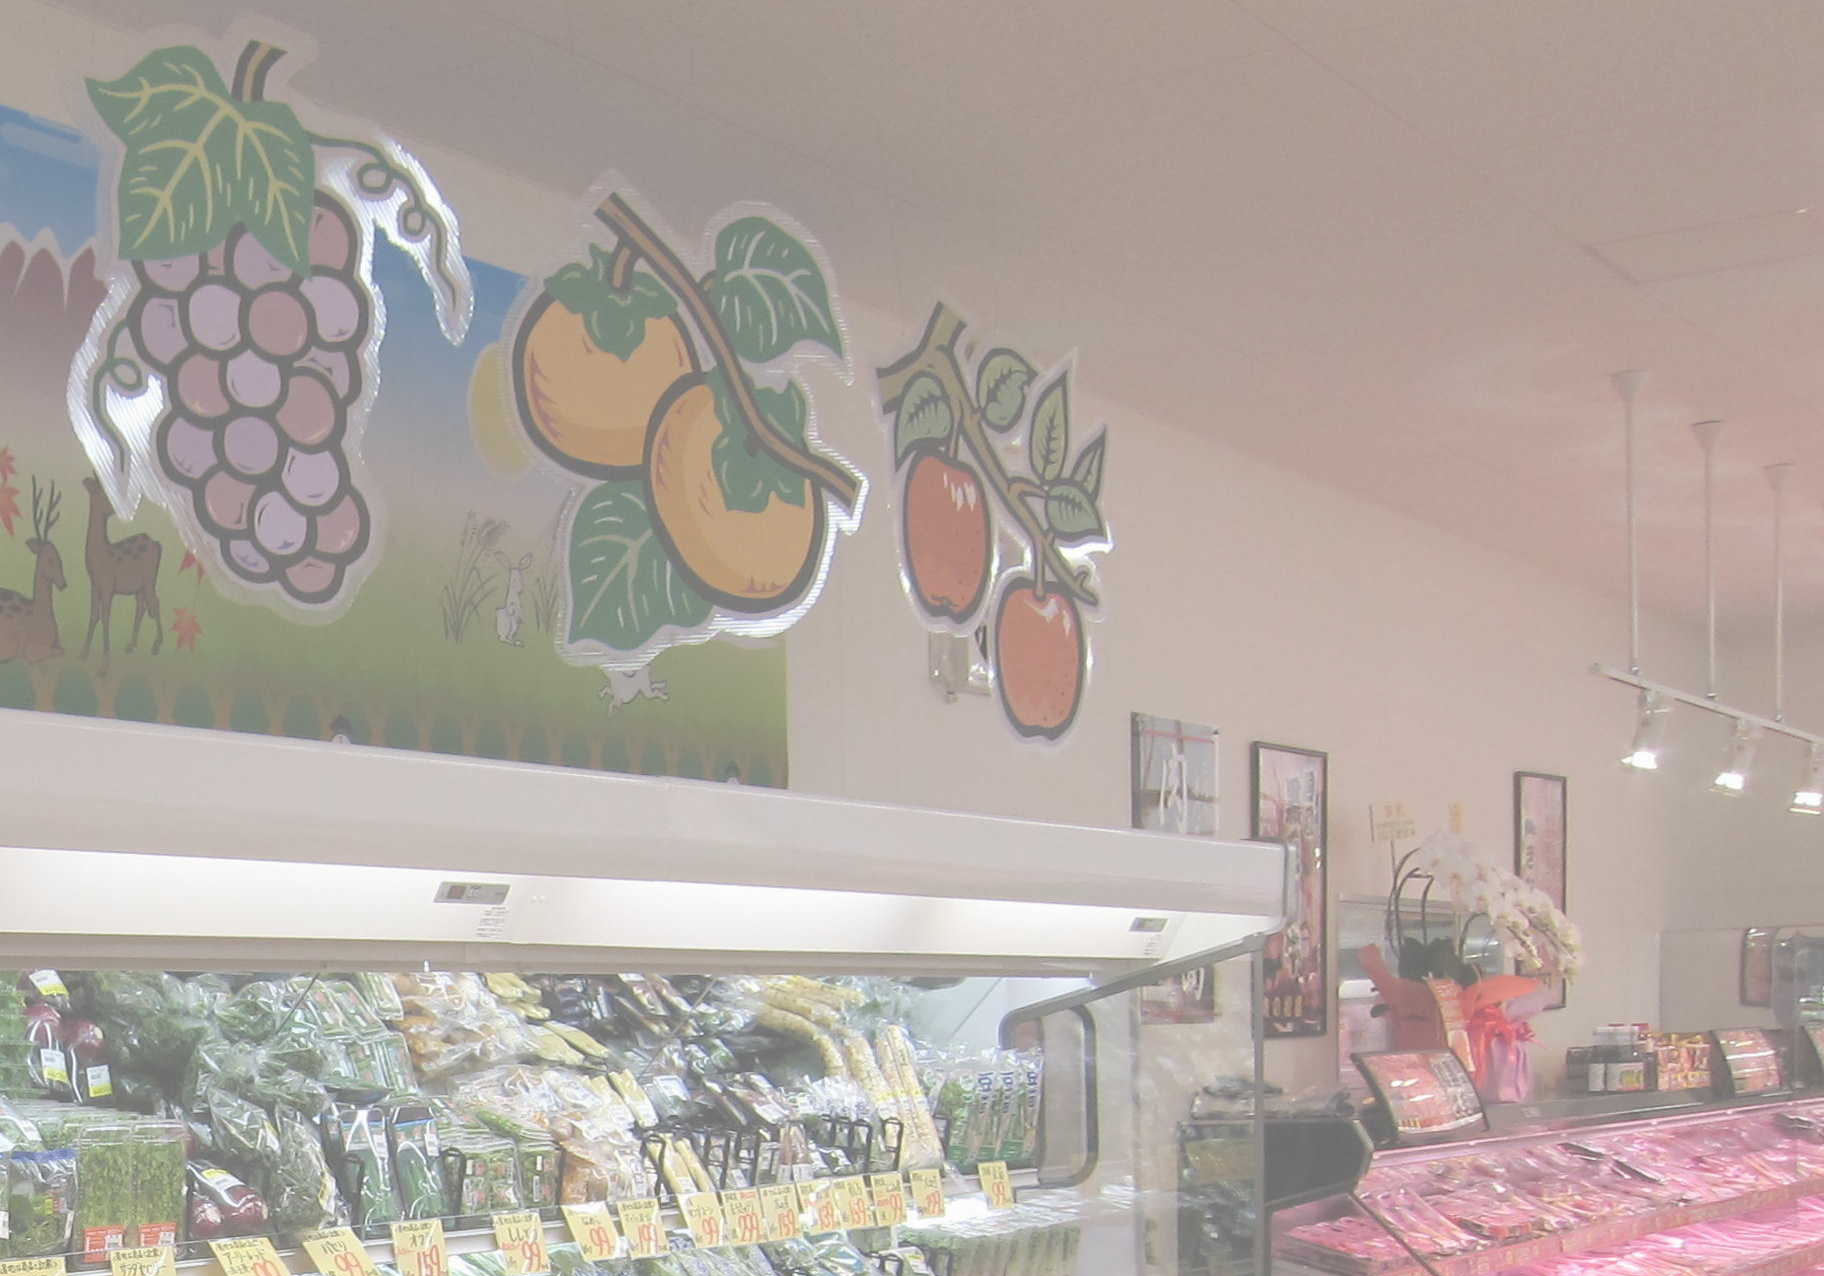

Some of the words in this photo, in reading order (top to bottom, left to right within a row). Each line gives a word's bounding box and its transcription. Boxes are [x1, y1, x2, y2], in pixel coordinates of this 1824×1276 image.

[590, 1227, 610, 1255] 99
[701, 1217, 720, 1244] 99
[522, 1241, 540, 1272] 99
